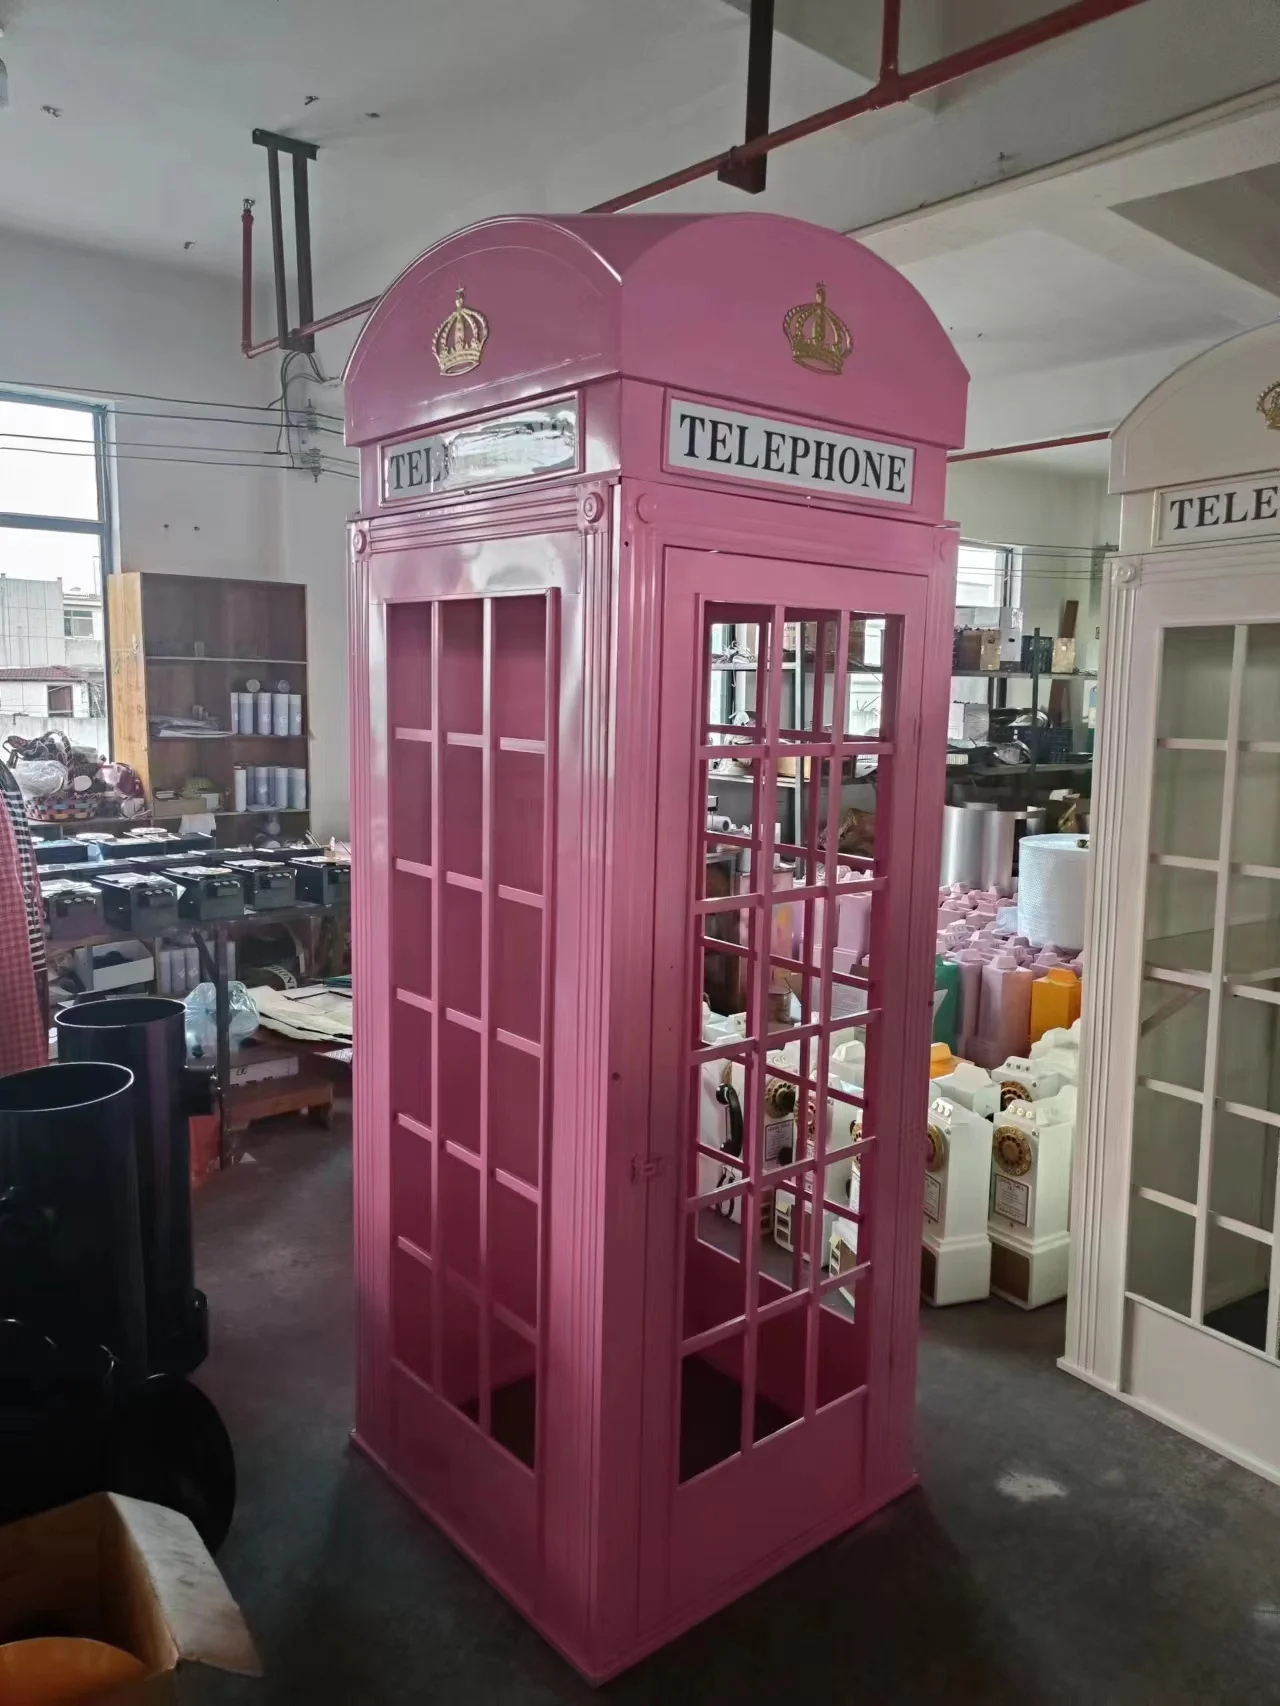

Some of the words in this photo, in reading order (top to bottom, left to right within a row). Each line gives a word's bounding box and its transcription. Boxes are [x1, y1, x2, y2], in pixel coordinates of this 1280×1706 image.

[390, 444, 449, 490] TEL
[680, 414, 906, 493] TELEPHONE
[1170, 486, 1279, 530] TELE
